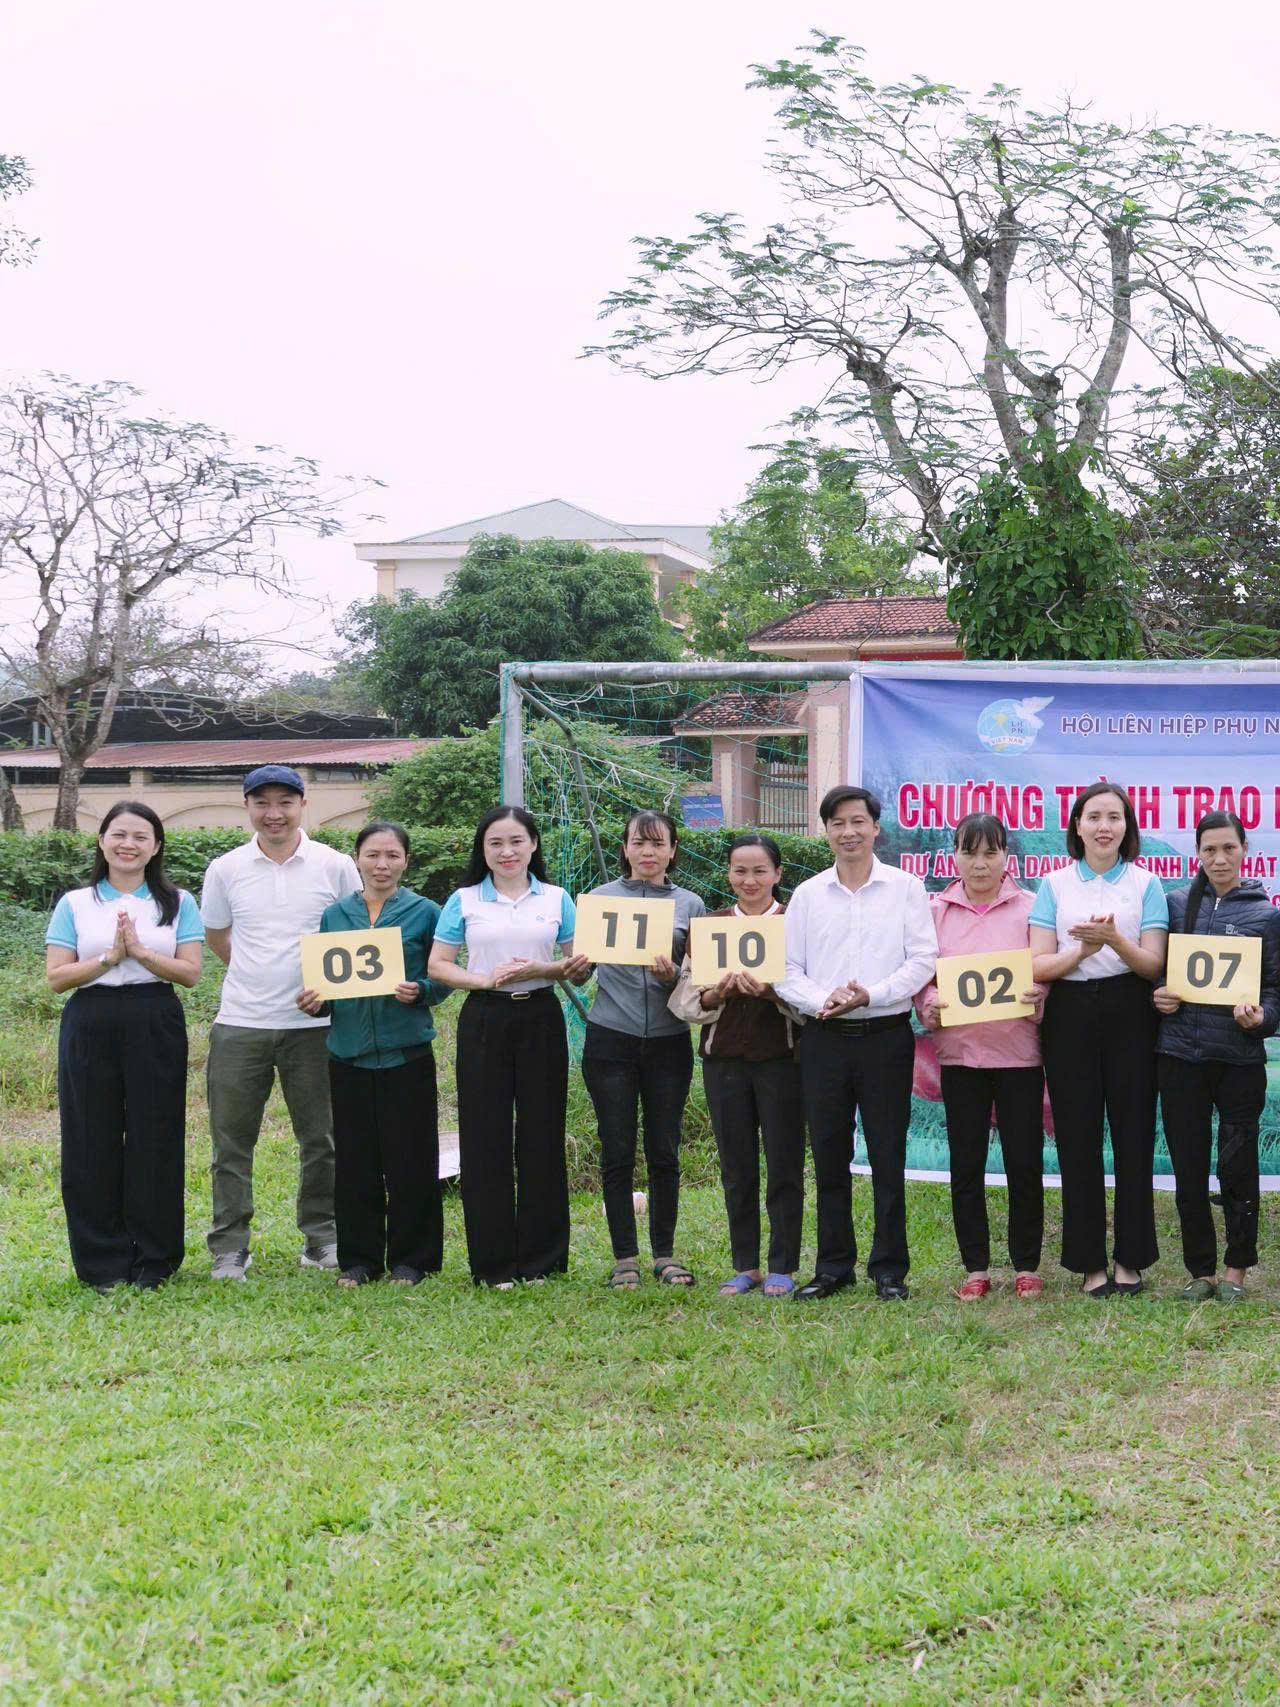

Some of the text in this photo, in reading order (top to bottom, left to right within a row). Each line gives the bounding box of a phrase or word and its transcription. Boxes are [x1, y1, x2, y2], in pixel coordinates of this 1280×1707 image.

[1062, 713, 1100, 736] HỘI
[1108, 714, 1151, 733] LIÊN
[1160, 714, 1206, 737] HIỆP
[1214, 718, 1257, 737] PHỤ
[899, 780, 1044, 829] CHƯƠNG
[1173, 786, 1260, 829] TRAO
[1241, 852, 1278, 877] HÁT
[602, 912, 648, 949] 11
[711, 930, 766, 968] 10
[322, 944, 384, 984] 03
[1186, 950, 1242, 988] 07
[957, 966, 1017, 1008] 02
